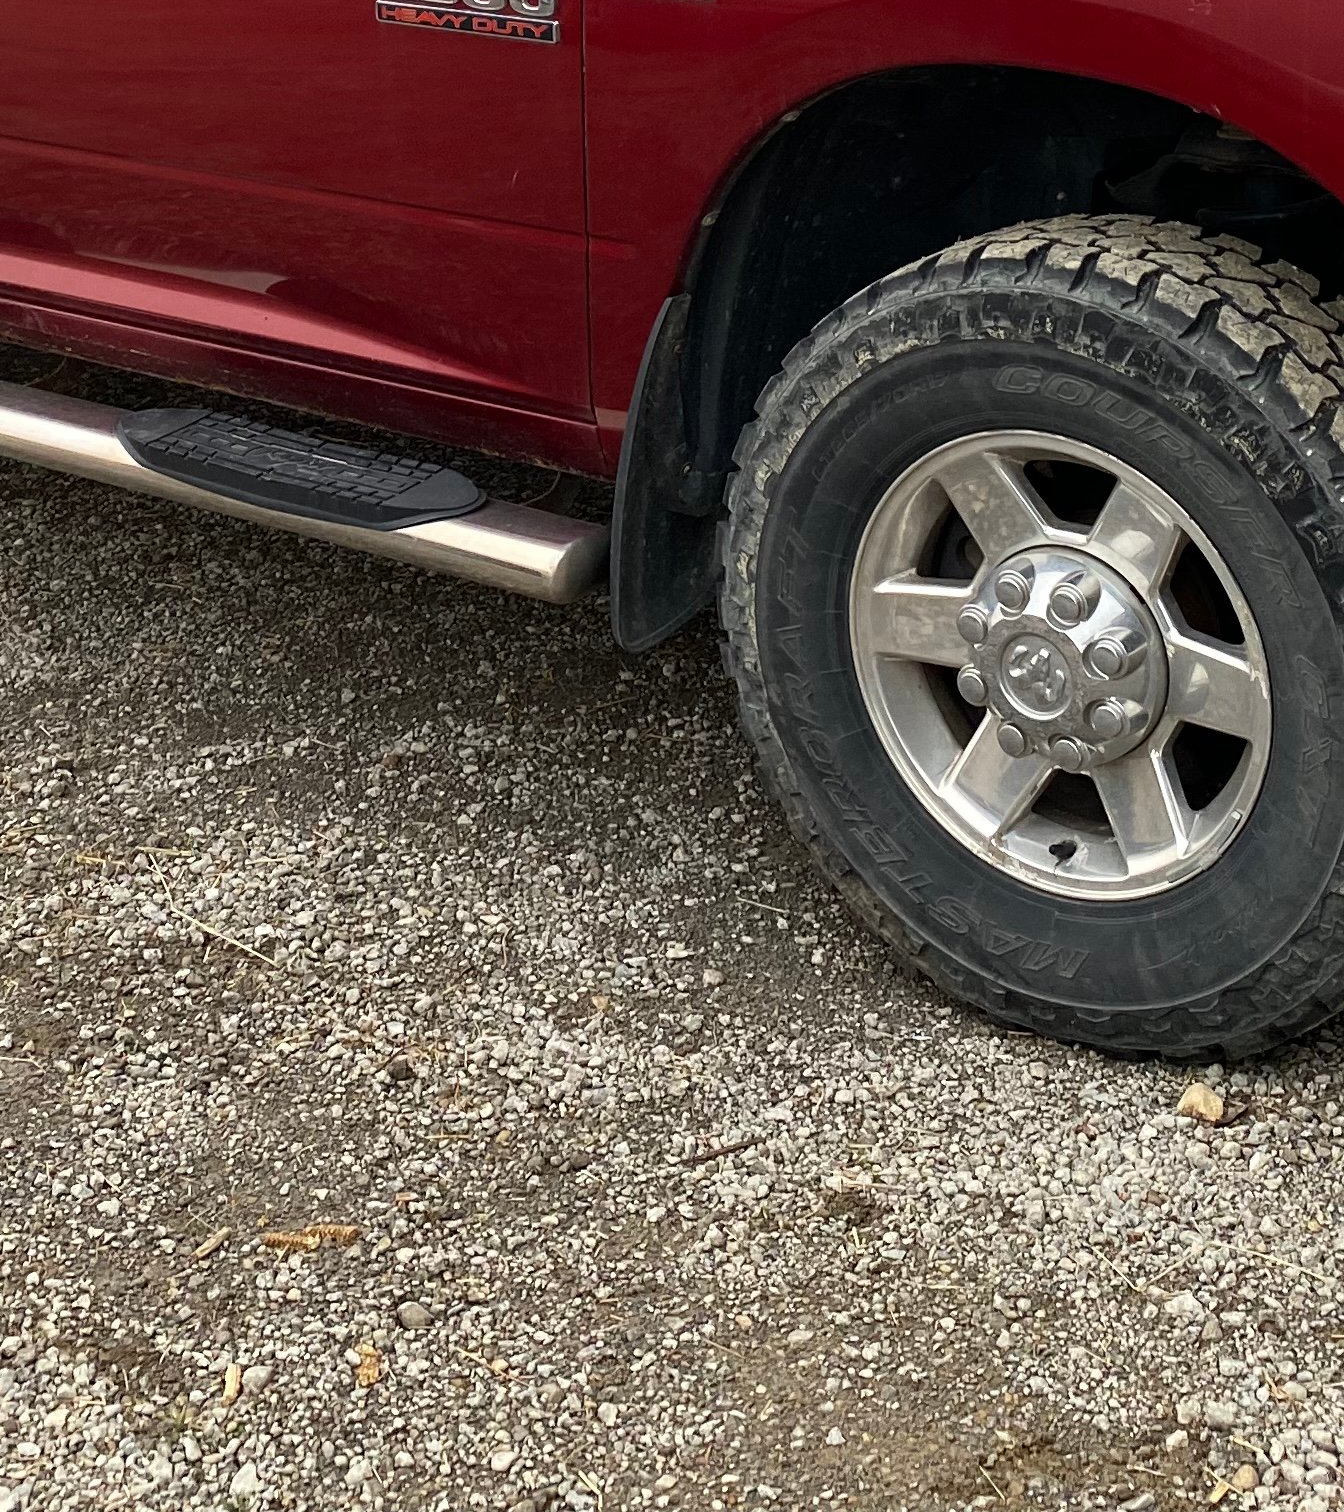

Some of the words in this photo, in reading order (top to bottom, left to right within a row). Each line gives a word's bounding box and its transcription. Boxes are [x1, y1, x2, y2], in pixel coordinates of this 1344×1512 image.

[380, 5, 462, 28] HEAVY
[471, 16, 549, 38] DUTY
[990, 362, 1304, 612] COURSER
[773, 508, 1090, 981] MASTERCRAFT
